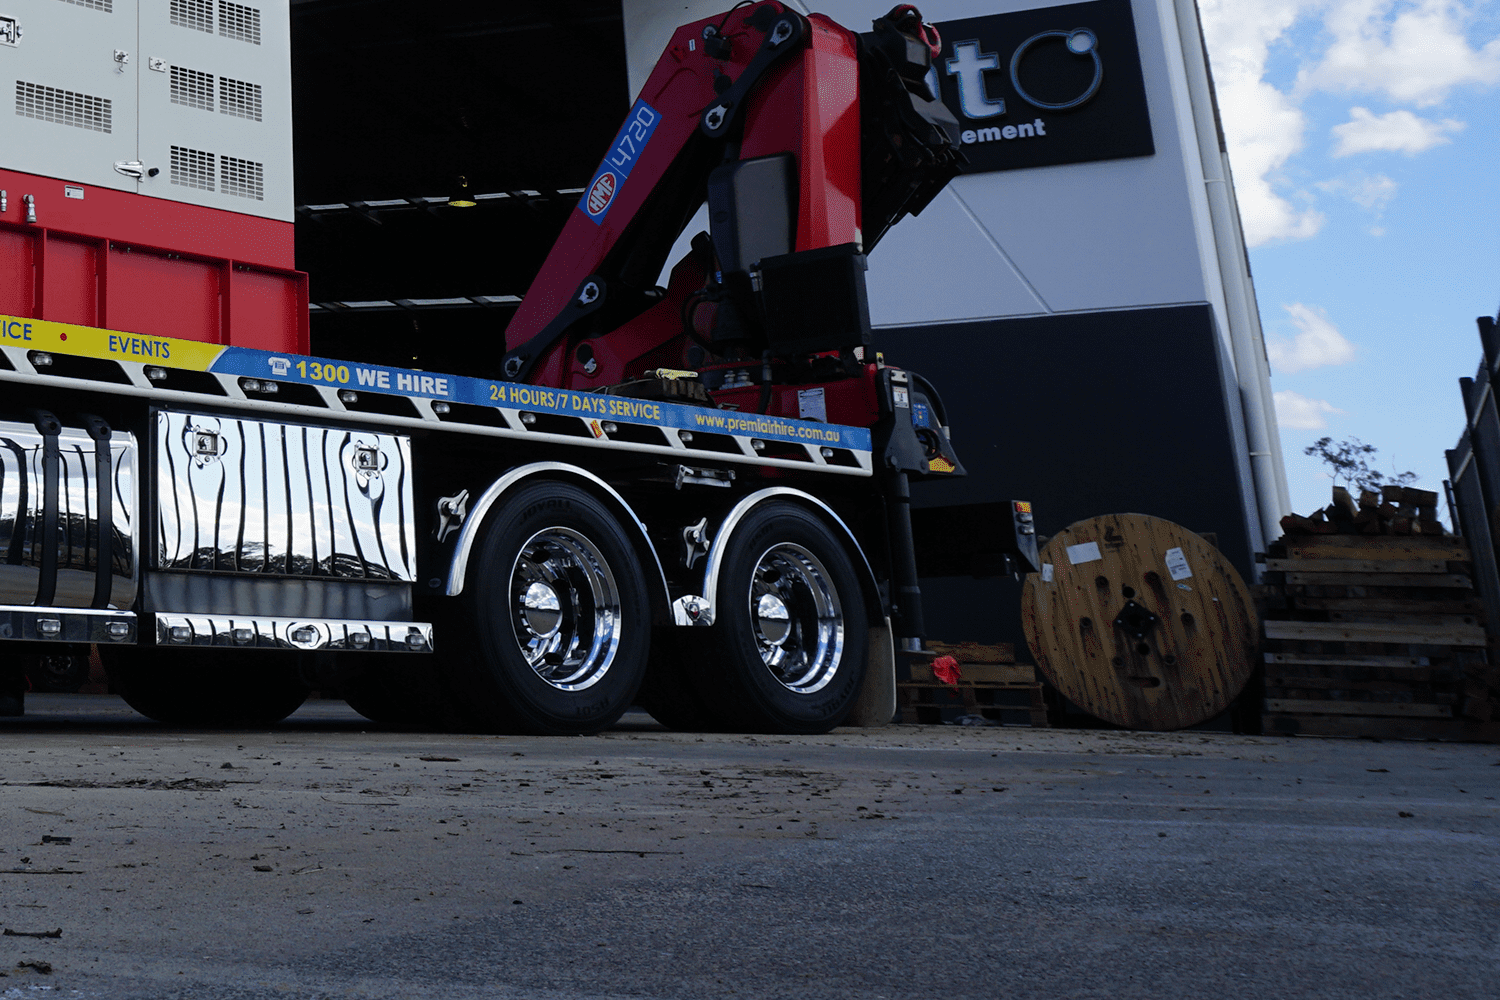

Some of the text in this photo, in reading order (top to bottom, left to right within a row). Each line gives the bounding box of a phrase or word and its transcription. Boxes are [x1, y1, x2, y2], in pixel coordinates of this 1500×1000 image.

[960, 117, 1047, 145] ement
[589, 106, 655, 212] HMF 4720
[108, 334, 171, 359] EVENTS
[296, 360, 449, 396] 1300 WE HIRE
[489, 384, 660, 420] 24 HOURS/7 DAYS SERVICE
[695, 412, 841, 443] www.premiairhire.com.au
